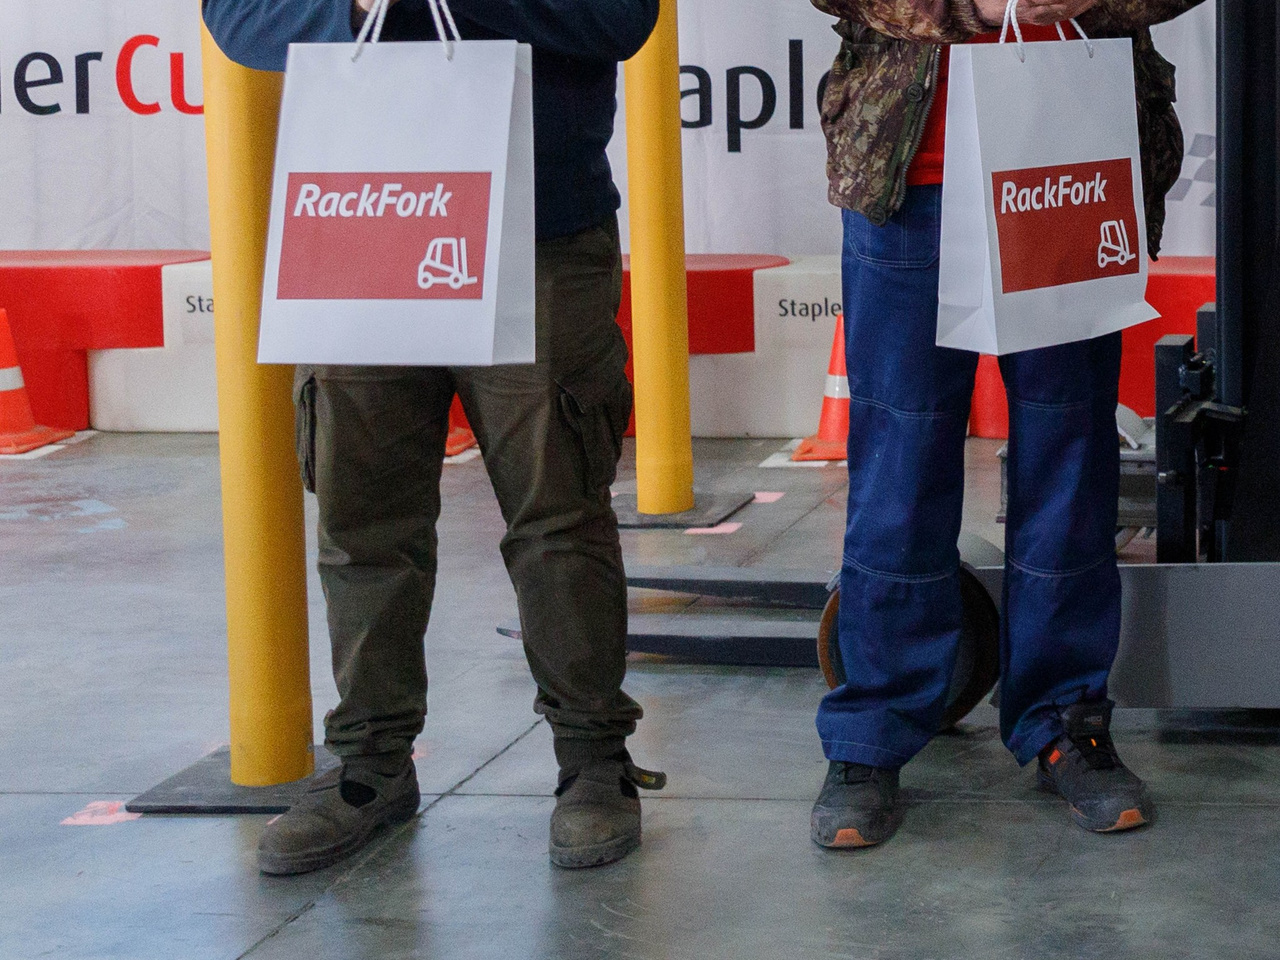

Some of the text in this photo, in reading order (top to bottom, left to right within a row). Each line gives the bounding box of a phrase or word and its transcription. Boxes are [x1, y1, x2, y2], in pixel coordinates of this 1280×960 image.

[0, 34, 204, 115] erCu
[679, 39, 831, 153] apl
[293, 183, 453, 217] RackFork
[1001, 172, 1107, 214] RackFork
[186, 295, 214, 313] Sta
[778, 297, 842, 321] Staple
